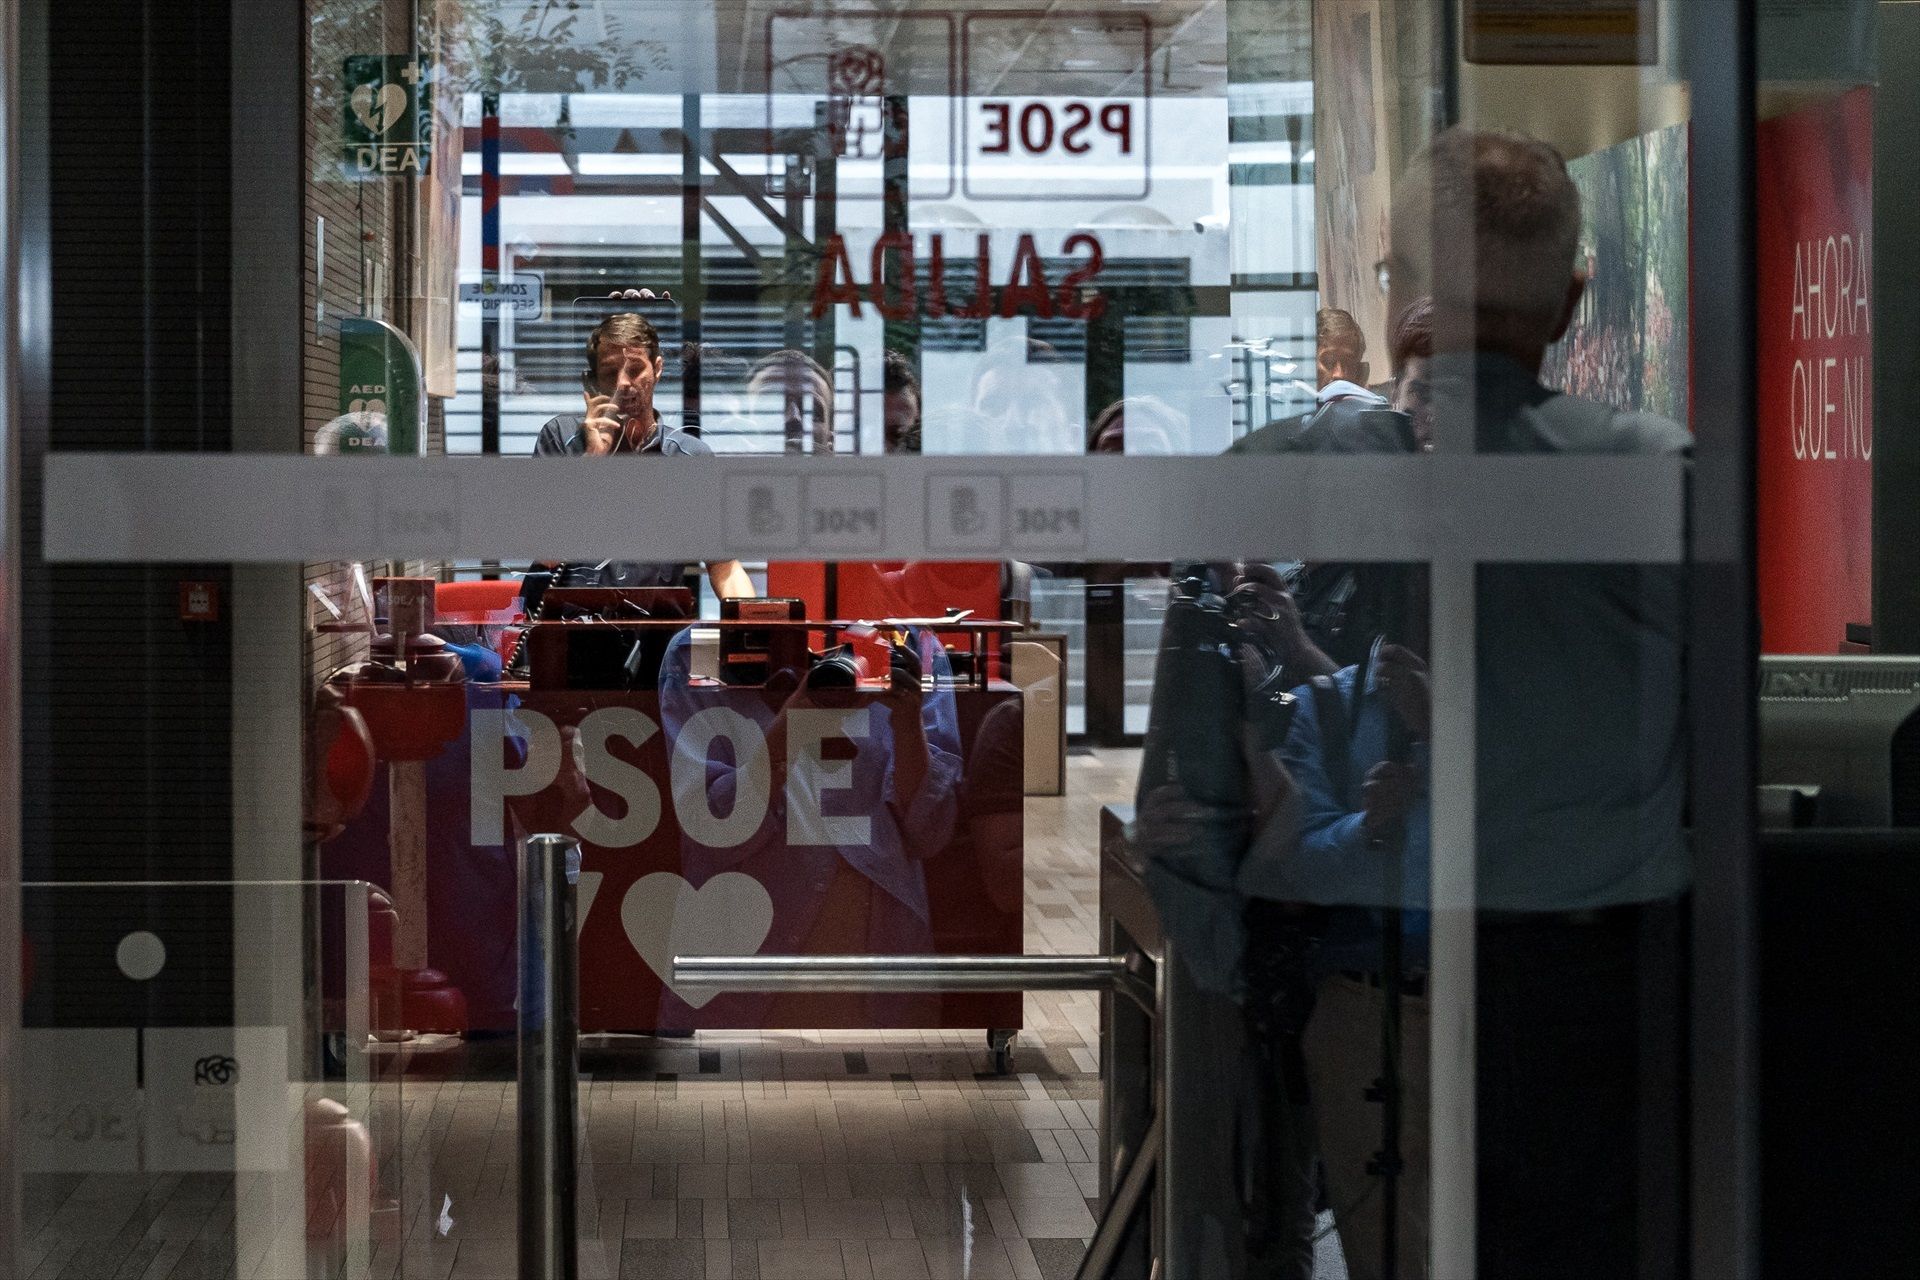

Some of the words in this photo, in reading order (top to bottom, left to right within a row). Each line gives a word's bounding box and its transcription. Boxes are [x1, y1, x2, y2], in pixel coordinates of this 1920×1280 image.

[357, 147, 422, 172] DEA
[1791, 232, 1870, 340] AHORA
[349, 384, 386, 394] AED
[1791, 358, 1837, 461] QUE
[348, 437, 386, 447] DEA
[470, 706, 871, 848] PSOE
